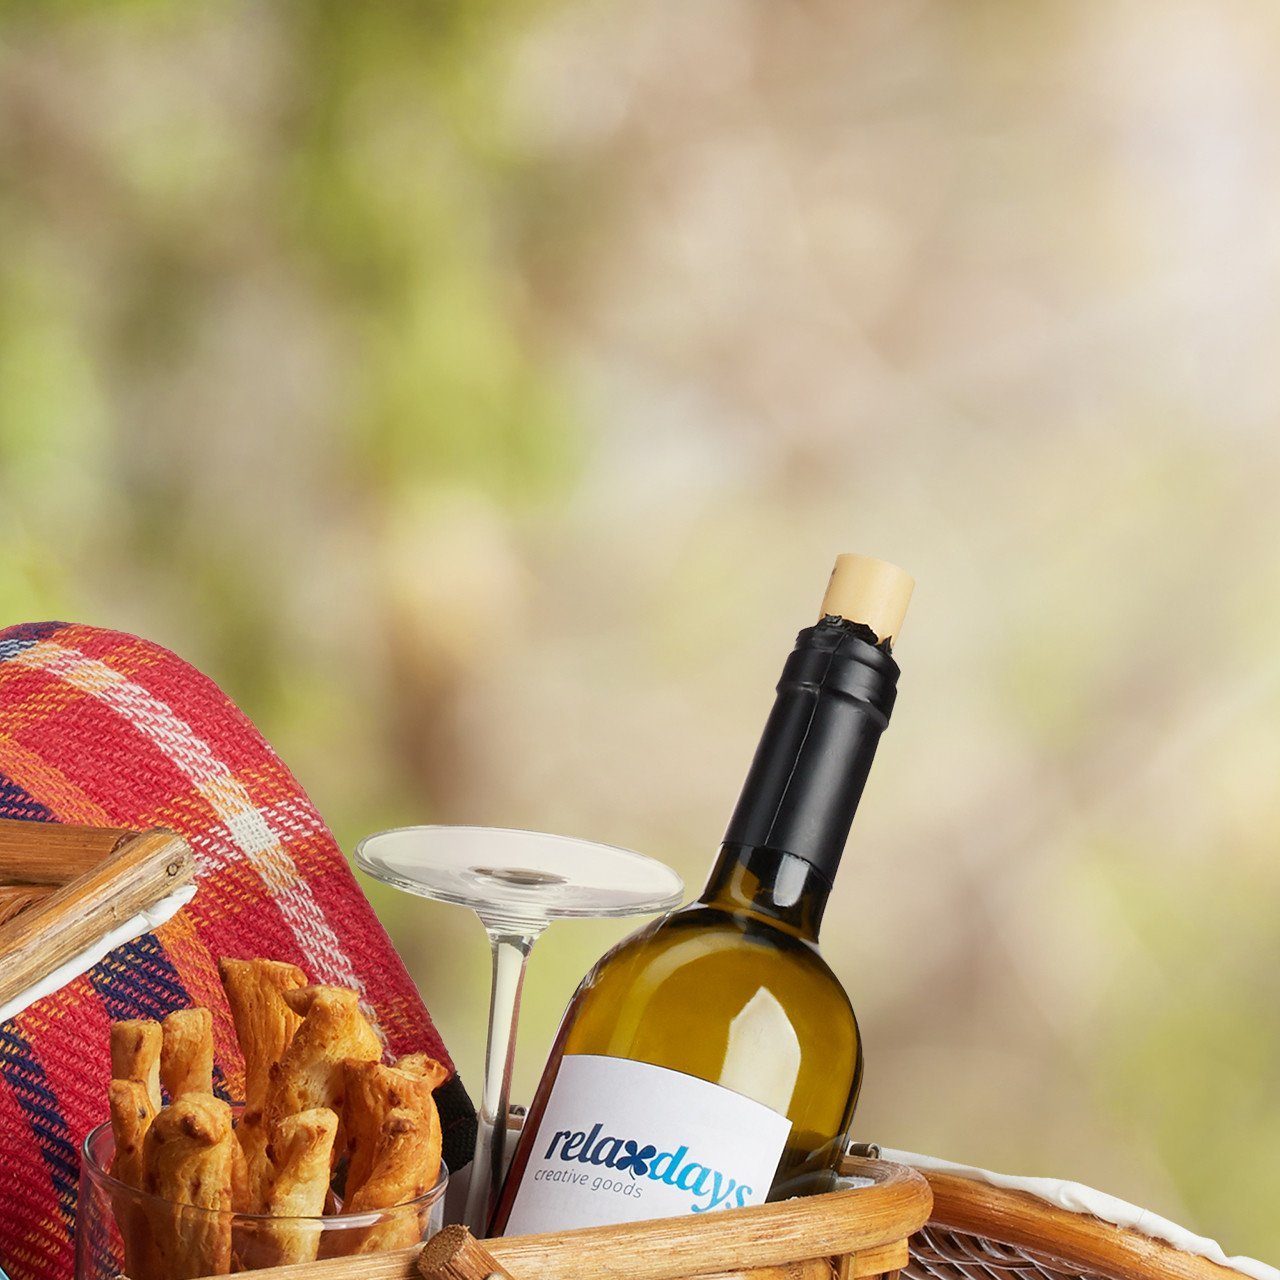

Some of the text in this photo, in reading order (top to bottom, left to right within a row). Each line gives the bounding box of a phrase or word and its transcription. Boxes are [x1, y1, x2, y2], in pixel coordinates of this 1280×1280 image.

[534, 1168, 644, 1199] creative goods
[544, 1124, 753, 1213] relaxdays
